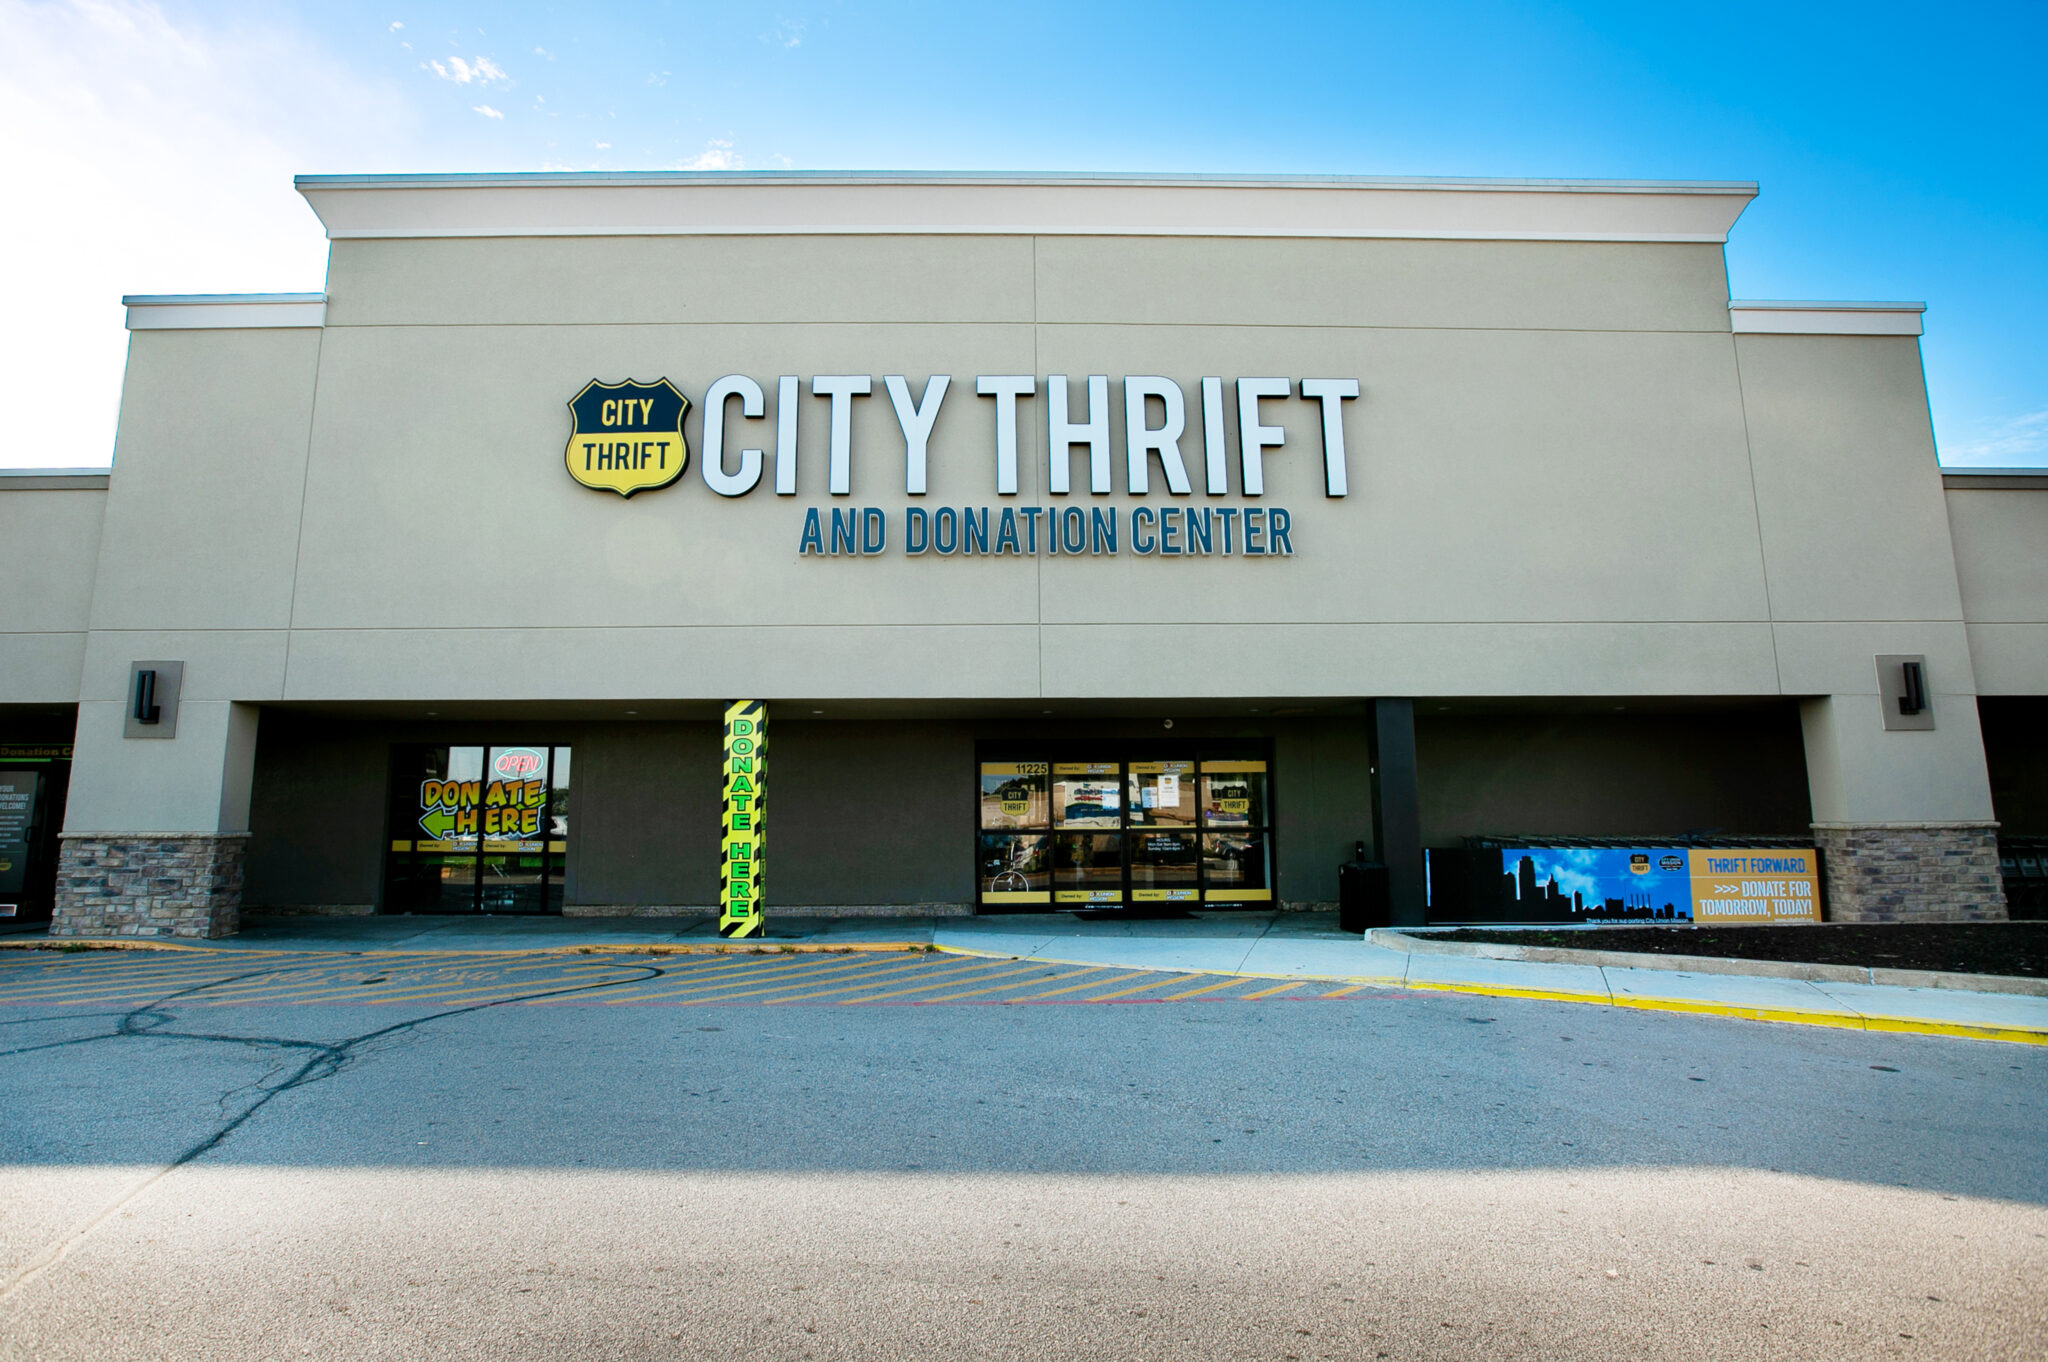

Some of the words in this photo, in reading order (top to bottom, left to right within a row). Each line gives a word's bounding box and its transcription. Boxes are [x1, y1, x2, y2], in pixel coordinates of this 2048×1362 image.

[601, 399, 653, 427] CITY
[701, 374, 952, 497] CITY
[976, 375, 1361, 498] THRIFT
[582, 442, 671, 471] THRIFT
[799, 507, 887, 556] AND
[905, 506, 1120, 556] DONATION
[1130, 506, 1295, 558] CENTER
[495, 755, 539, 772] OPEN
[1016, 763, 1047, 774] 11225
[731, 719, 753, 831] DONATE
[424, 779, 541, 807] DONATE
[1008, 791, 1022, 799] CITY
[1227, 789, 1241, 798] CITY
[1004, 803, 1026, 812] THRIFT
[1223, 800, 1246, 810] THRIFT
[456, 808, 538, 834] HERE
[1707, 858, 1748, 873] THRIFT
[730, 842, 752, 917] HERE
[1741, 881, 1787, 897] DONATE
[1789, 881, 1812, 897] FOR
[1700, 899, 1771, 917] TOMORROW,
[1772, 899, 1813, 915] TODAY!
